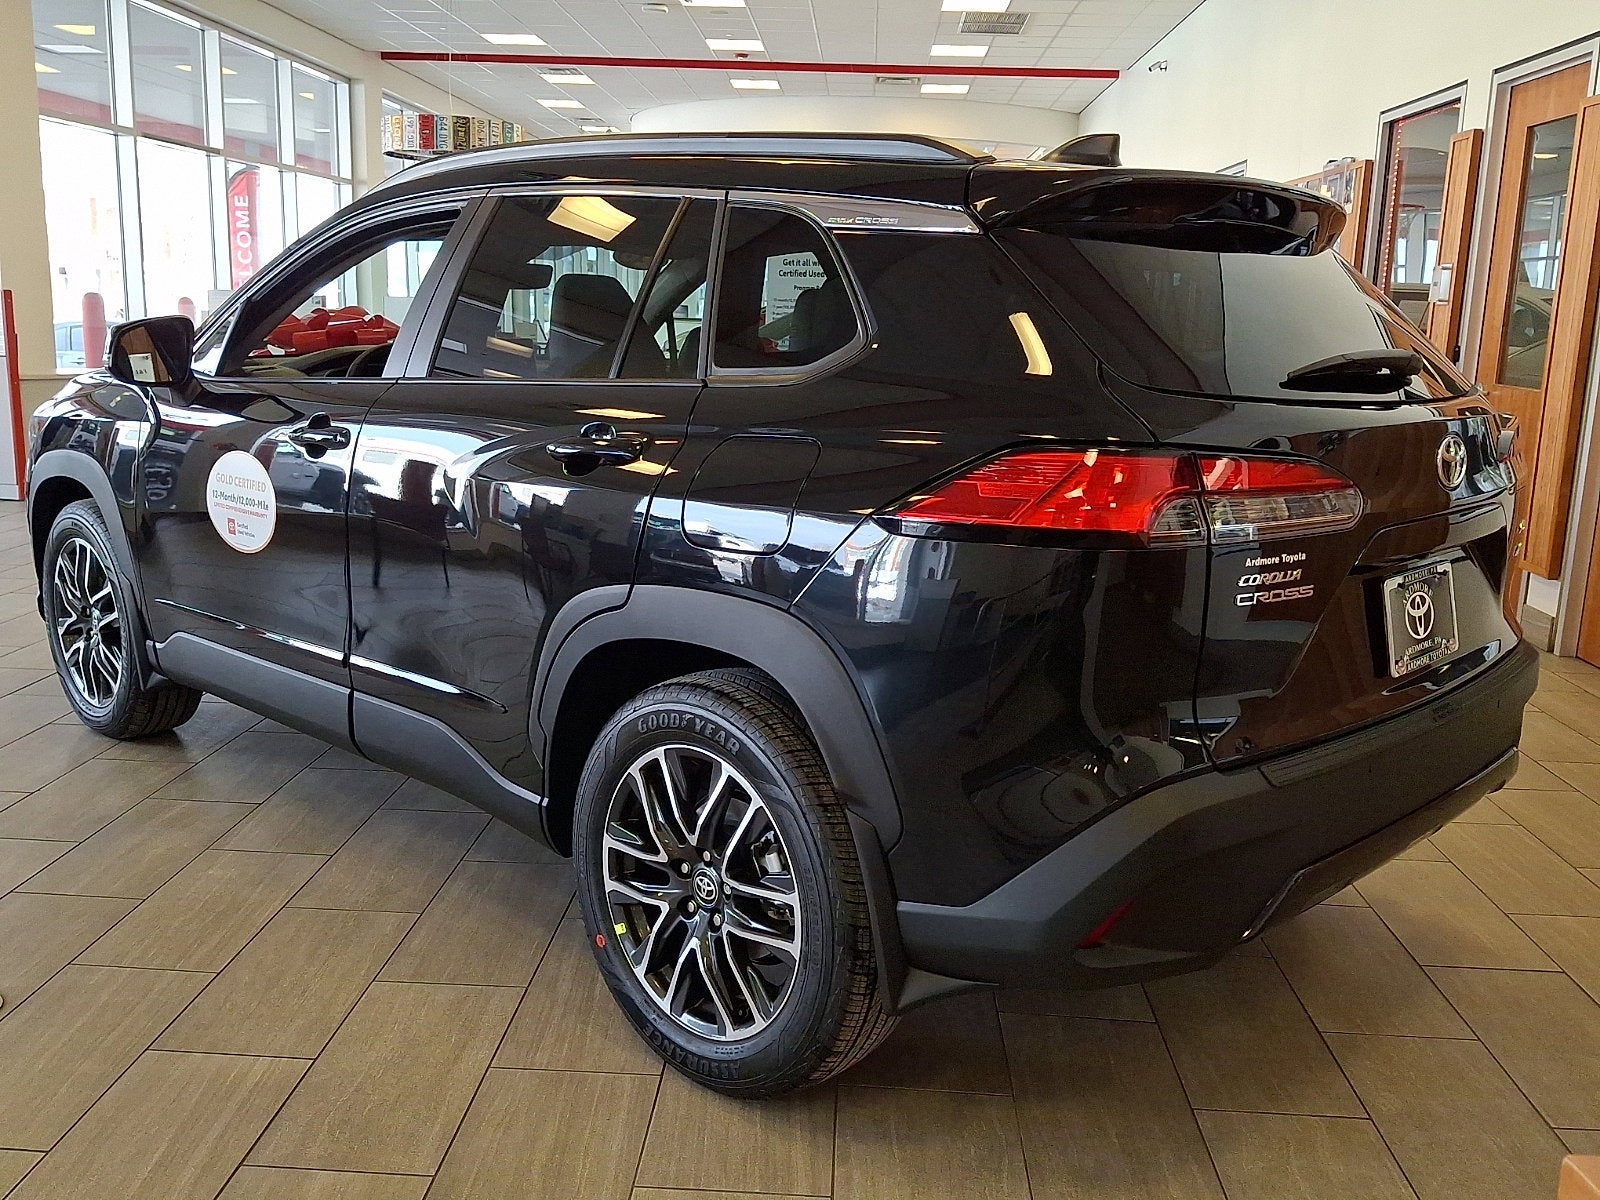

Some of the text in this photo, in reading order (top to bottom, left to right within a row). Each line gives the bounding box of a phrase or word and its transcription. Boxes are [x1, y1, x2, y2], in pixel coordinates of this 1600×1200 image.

[438, 116, 448, 131] 644
[782, 258, 795, 266] Get
[796, 258, 801, 266] it
[802, 258, 811, 266] all
[778, 269, 807, 278] Certified
[215, 472, 267, 493] GOLD CERTIFIED
[1245, 551, 1307, 567] Ardmore Toyota
[1237, 568, 1302, 587] COROLLA
[1236, 585, 1314, 606] CROSS
[1407, 655, 1430, 671] ARDMORE
